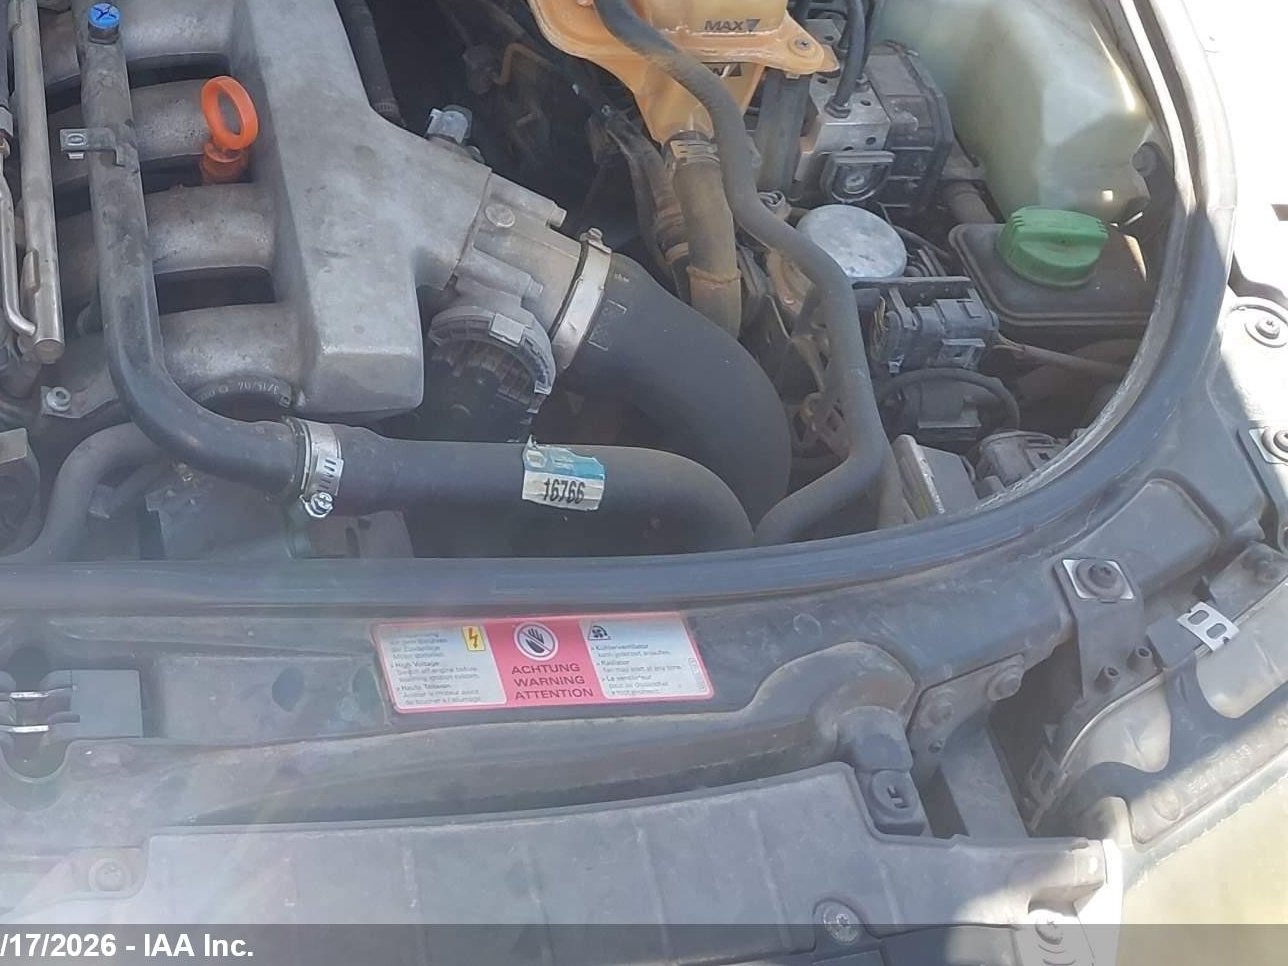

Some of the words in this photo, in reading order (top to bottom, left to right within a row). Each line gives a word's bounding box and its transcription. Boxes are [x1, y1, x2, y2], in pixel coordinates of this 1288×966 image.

[704, 19, 744, 31] MAX
[543, 477, 585, 505] 16766
[512, 662, 581, 675] ACHTUNG
[514, 675, 585, 688] WARNING
[515, 688, 594, 700] ATTENTION
